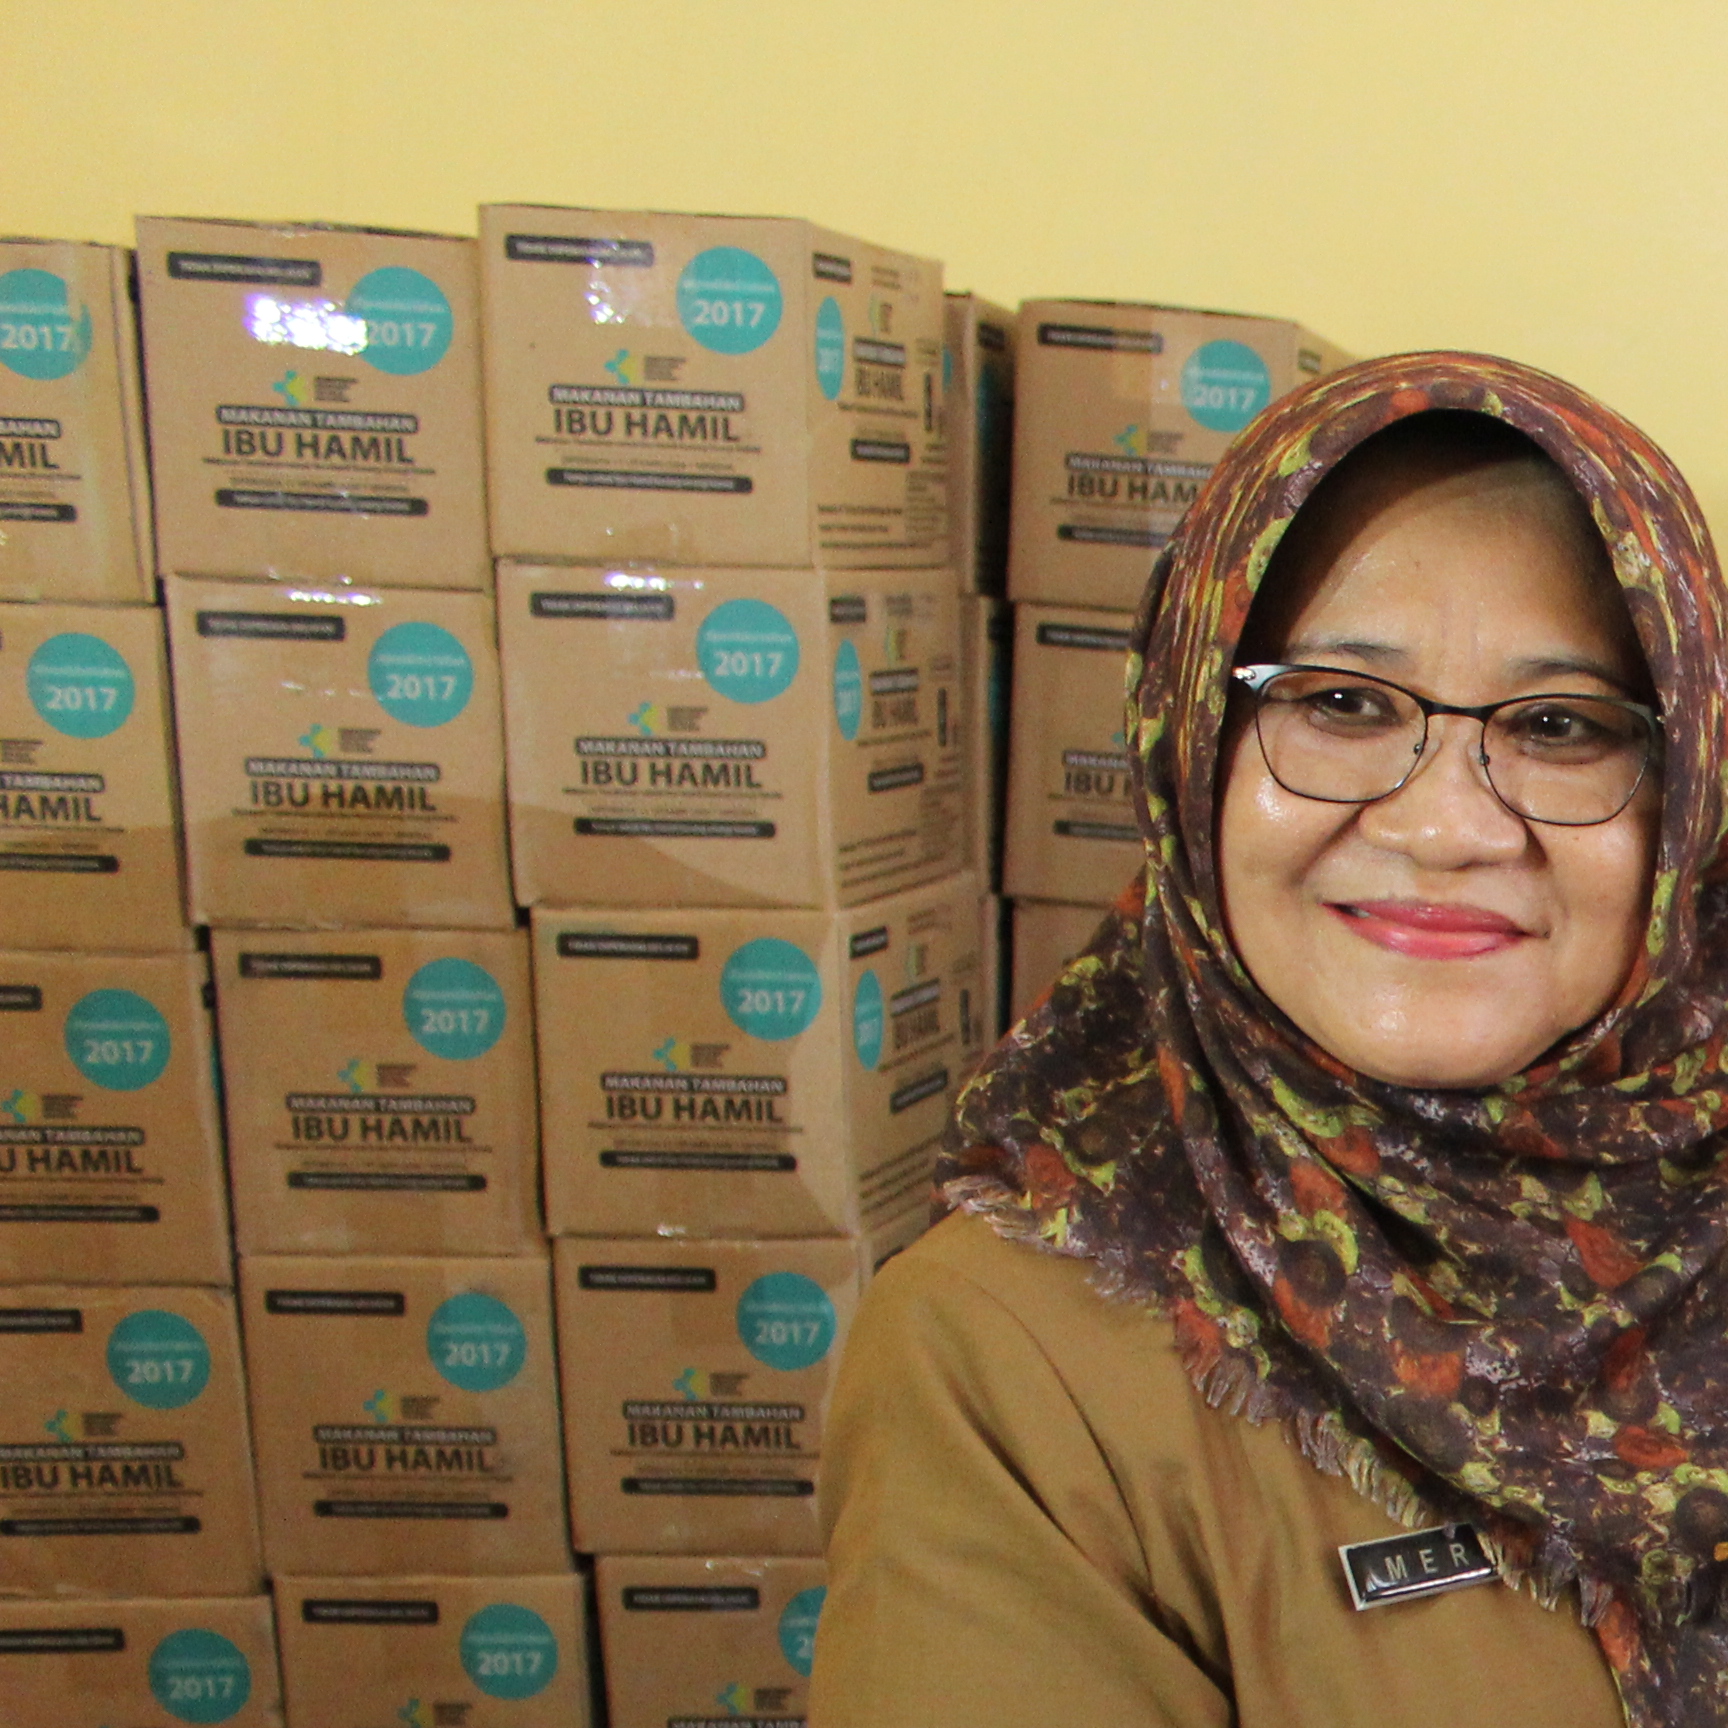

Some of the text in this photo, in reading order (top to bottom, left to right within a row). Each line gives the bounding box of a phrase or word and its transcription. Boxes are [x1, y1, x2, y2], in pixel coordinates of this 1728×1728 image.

[694, 302, 765, 328] 2017
[367, 322, 436, 349] 2017
[1193, 384, 1256, 411] 2017
[554, 410, 740, 443] IBU HAMIL
[223, 429, 414, 464] IBU HAMIL
[715, 652, 784, 678] 2017
[48, 686, 117, 711] 2017
[386, 675, 455, 700] 2017
[581, 760, 761, 790] IBU HAMIL
[251, 780, 435, 812] IBU HAMIL
[738, 989, 805, 1014] 2017
[422, 1009, 490, 1035] 2017
[86, 1041, 154, 1066] 2017
[606, 1095, 782, 1123] IBU HAMIL
[293, 1116, 471, 1144] IBU HAMIL
[29, 1149, 142, 1173] HAMIL
[755, 1322, 820, 1347] 2017
[444, 1342, 509, 1367] 2017
[627, 1422, 799, 1448] IBU HAMIL
[320, 1446, 492, 1472] IBU HAMIL
[1384, 1542, 1471, 1582] MER
